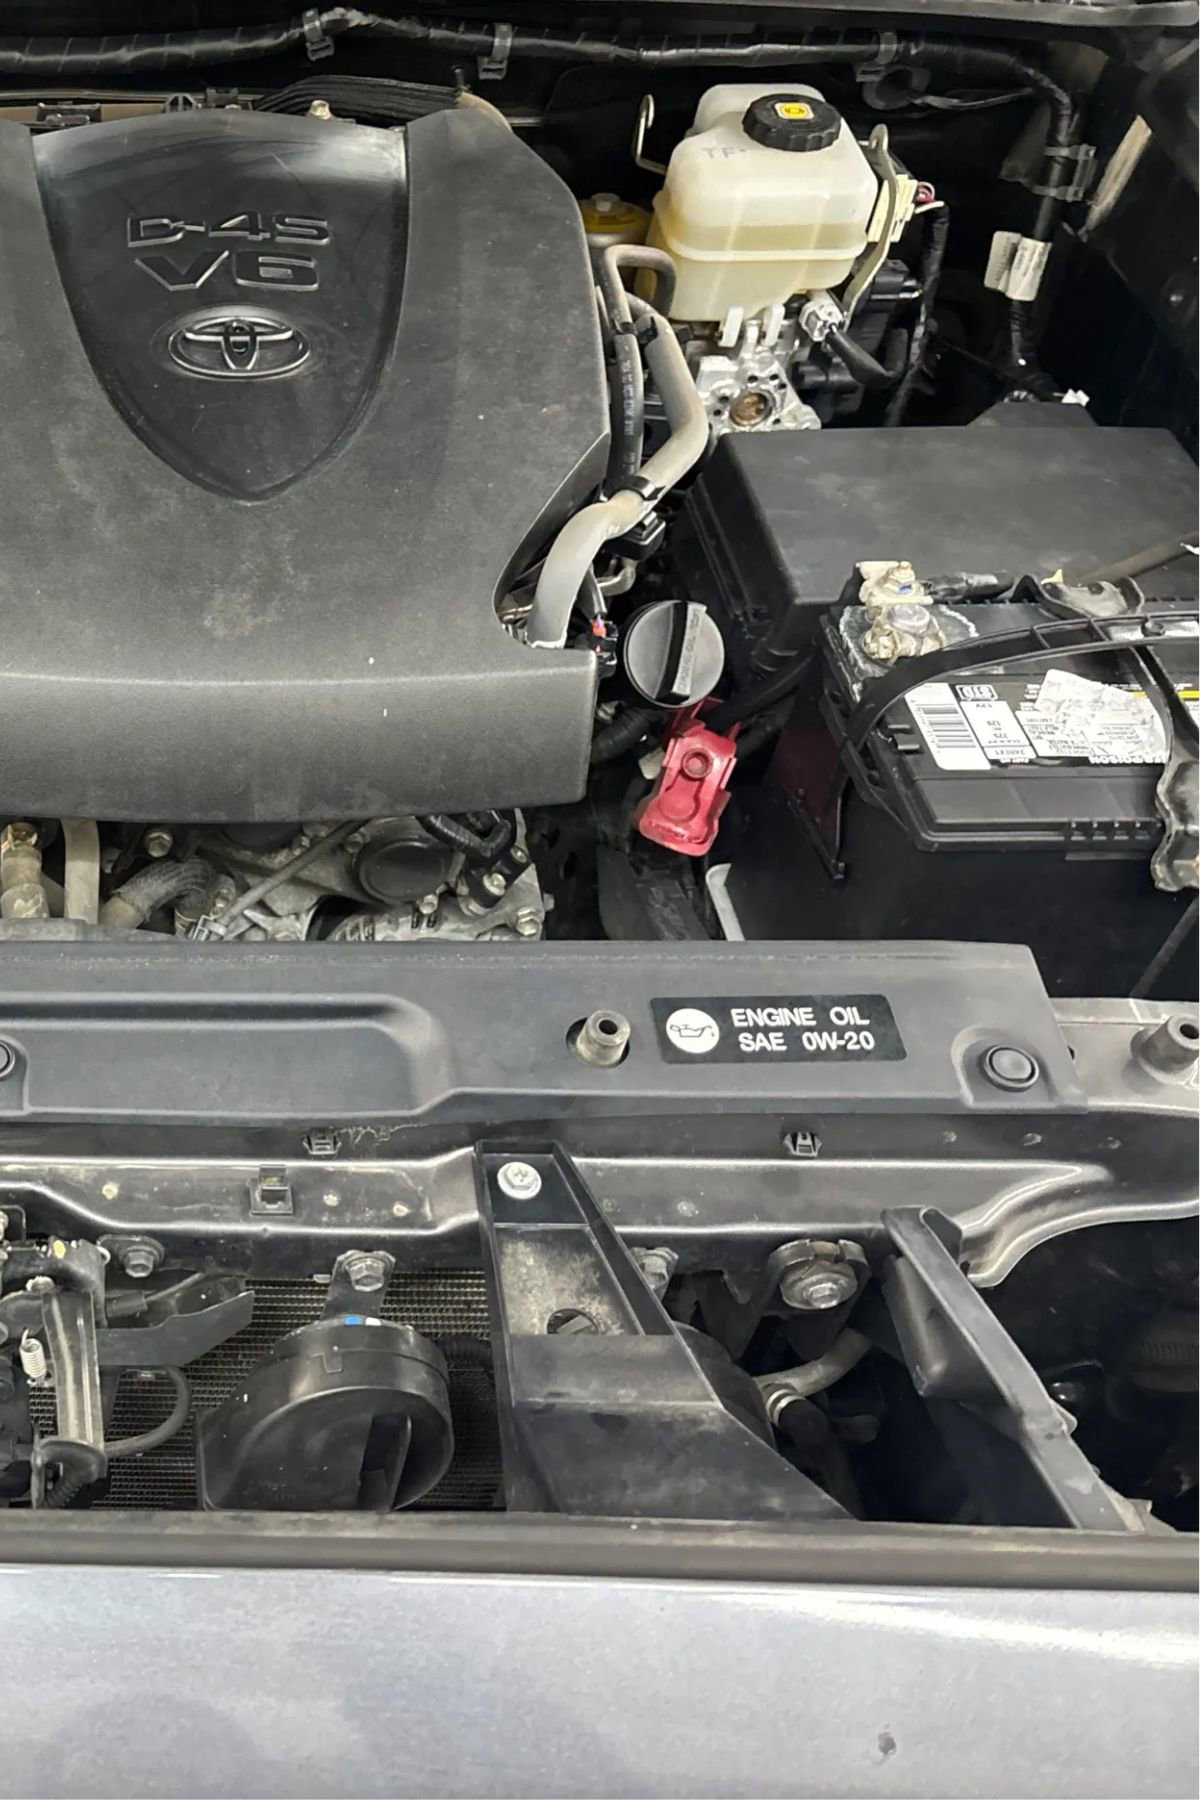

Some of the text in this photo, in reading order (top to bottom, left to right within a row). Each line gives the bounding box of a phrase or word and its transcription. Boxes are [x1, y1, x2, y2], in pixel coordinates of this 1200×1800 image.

[127, 211, 330, 248] D-4S
[135, 250, 320, 292] V6
[731, 1006, 870, 1028] ENGINE OIL
[739, 1030, 875, 1052] SAE 0W-20
